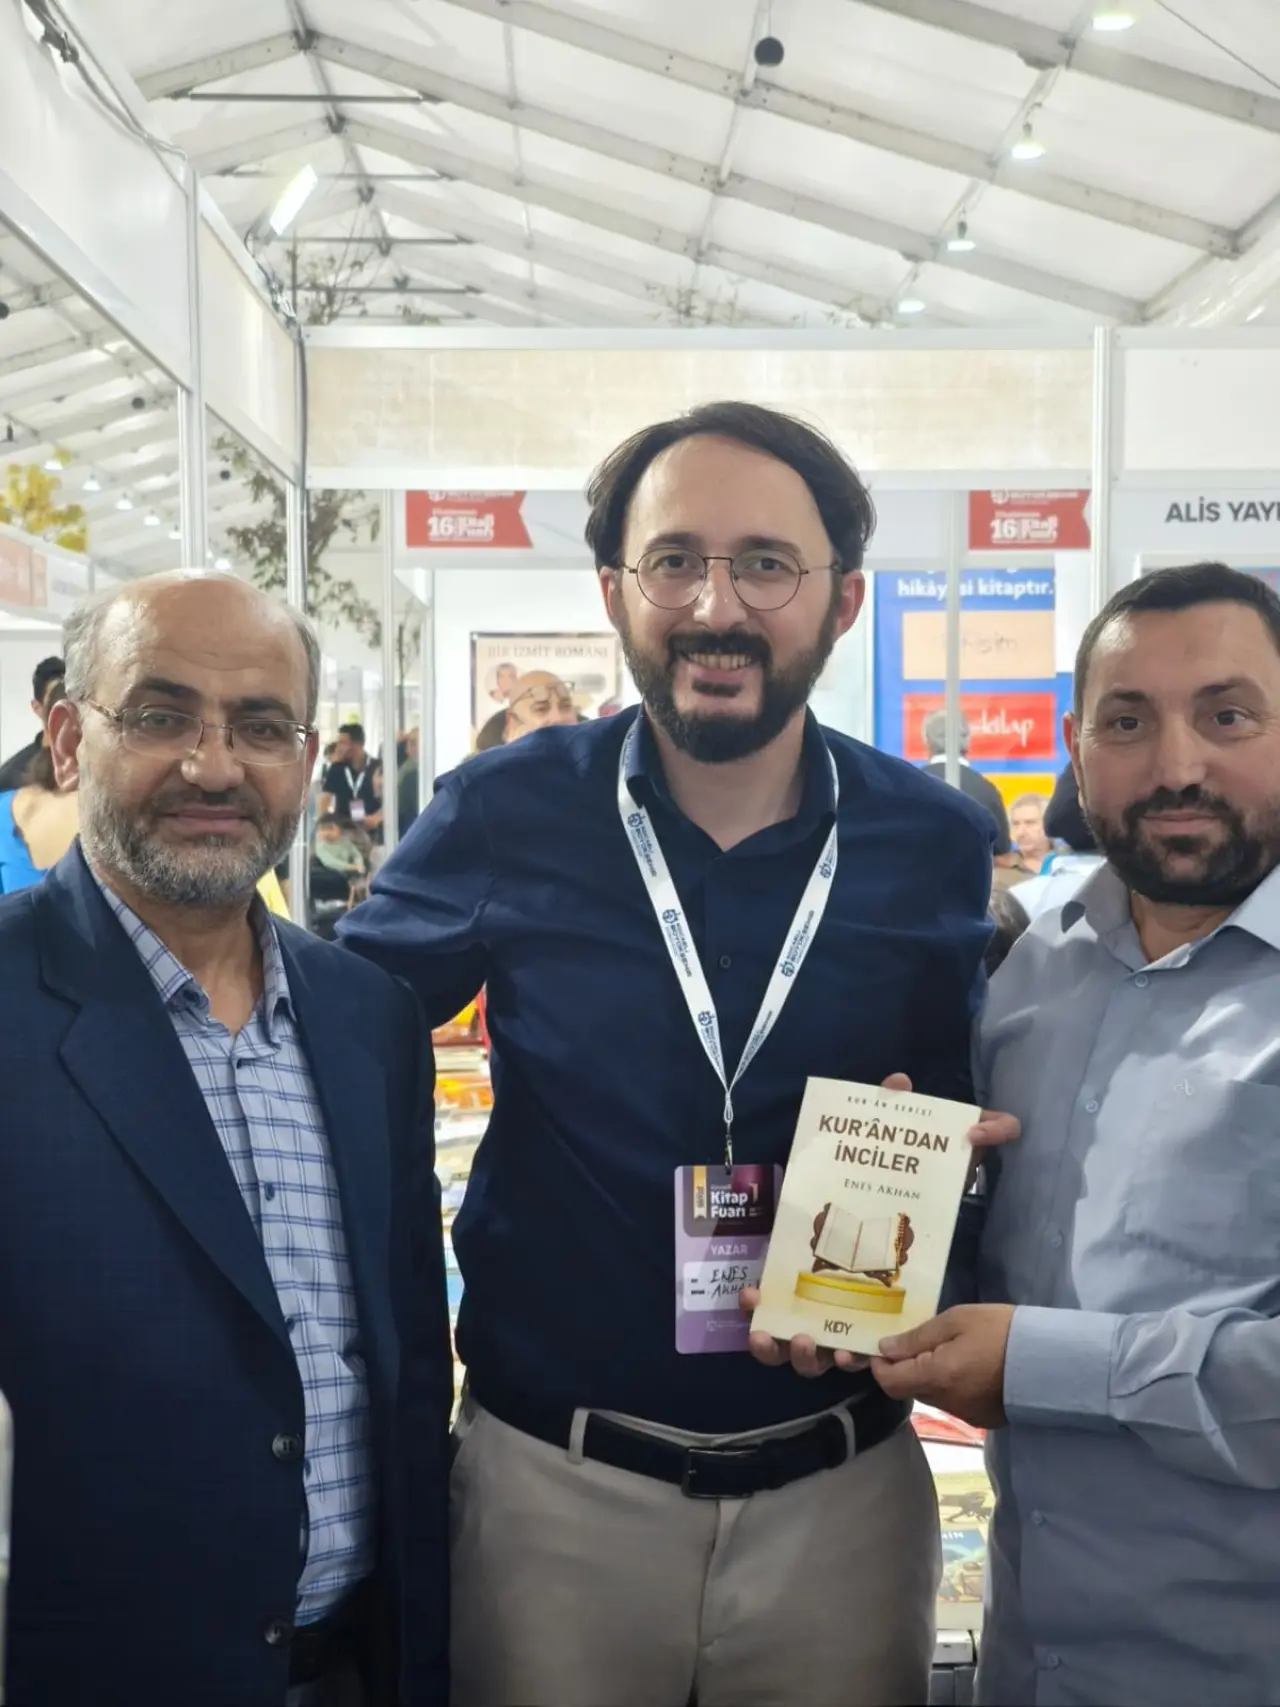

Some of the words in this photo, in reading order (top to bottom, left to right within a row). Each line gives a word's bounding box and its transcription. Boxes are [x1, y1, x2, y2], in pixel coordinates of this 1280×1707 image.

[1165, 496, 1220, 523] ALİS
[834, 1139, 920, 1174] İNCİLER
[711, 1190, 748, 1205] Kitap
[877, 1184, 921, 1200] AKHAN
[711, 1205, 746, 1218] Fuarı
[710, 1243, 748, 1256] YAZAR
[710, 1265, 748, 1283] ENES
